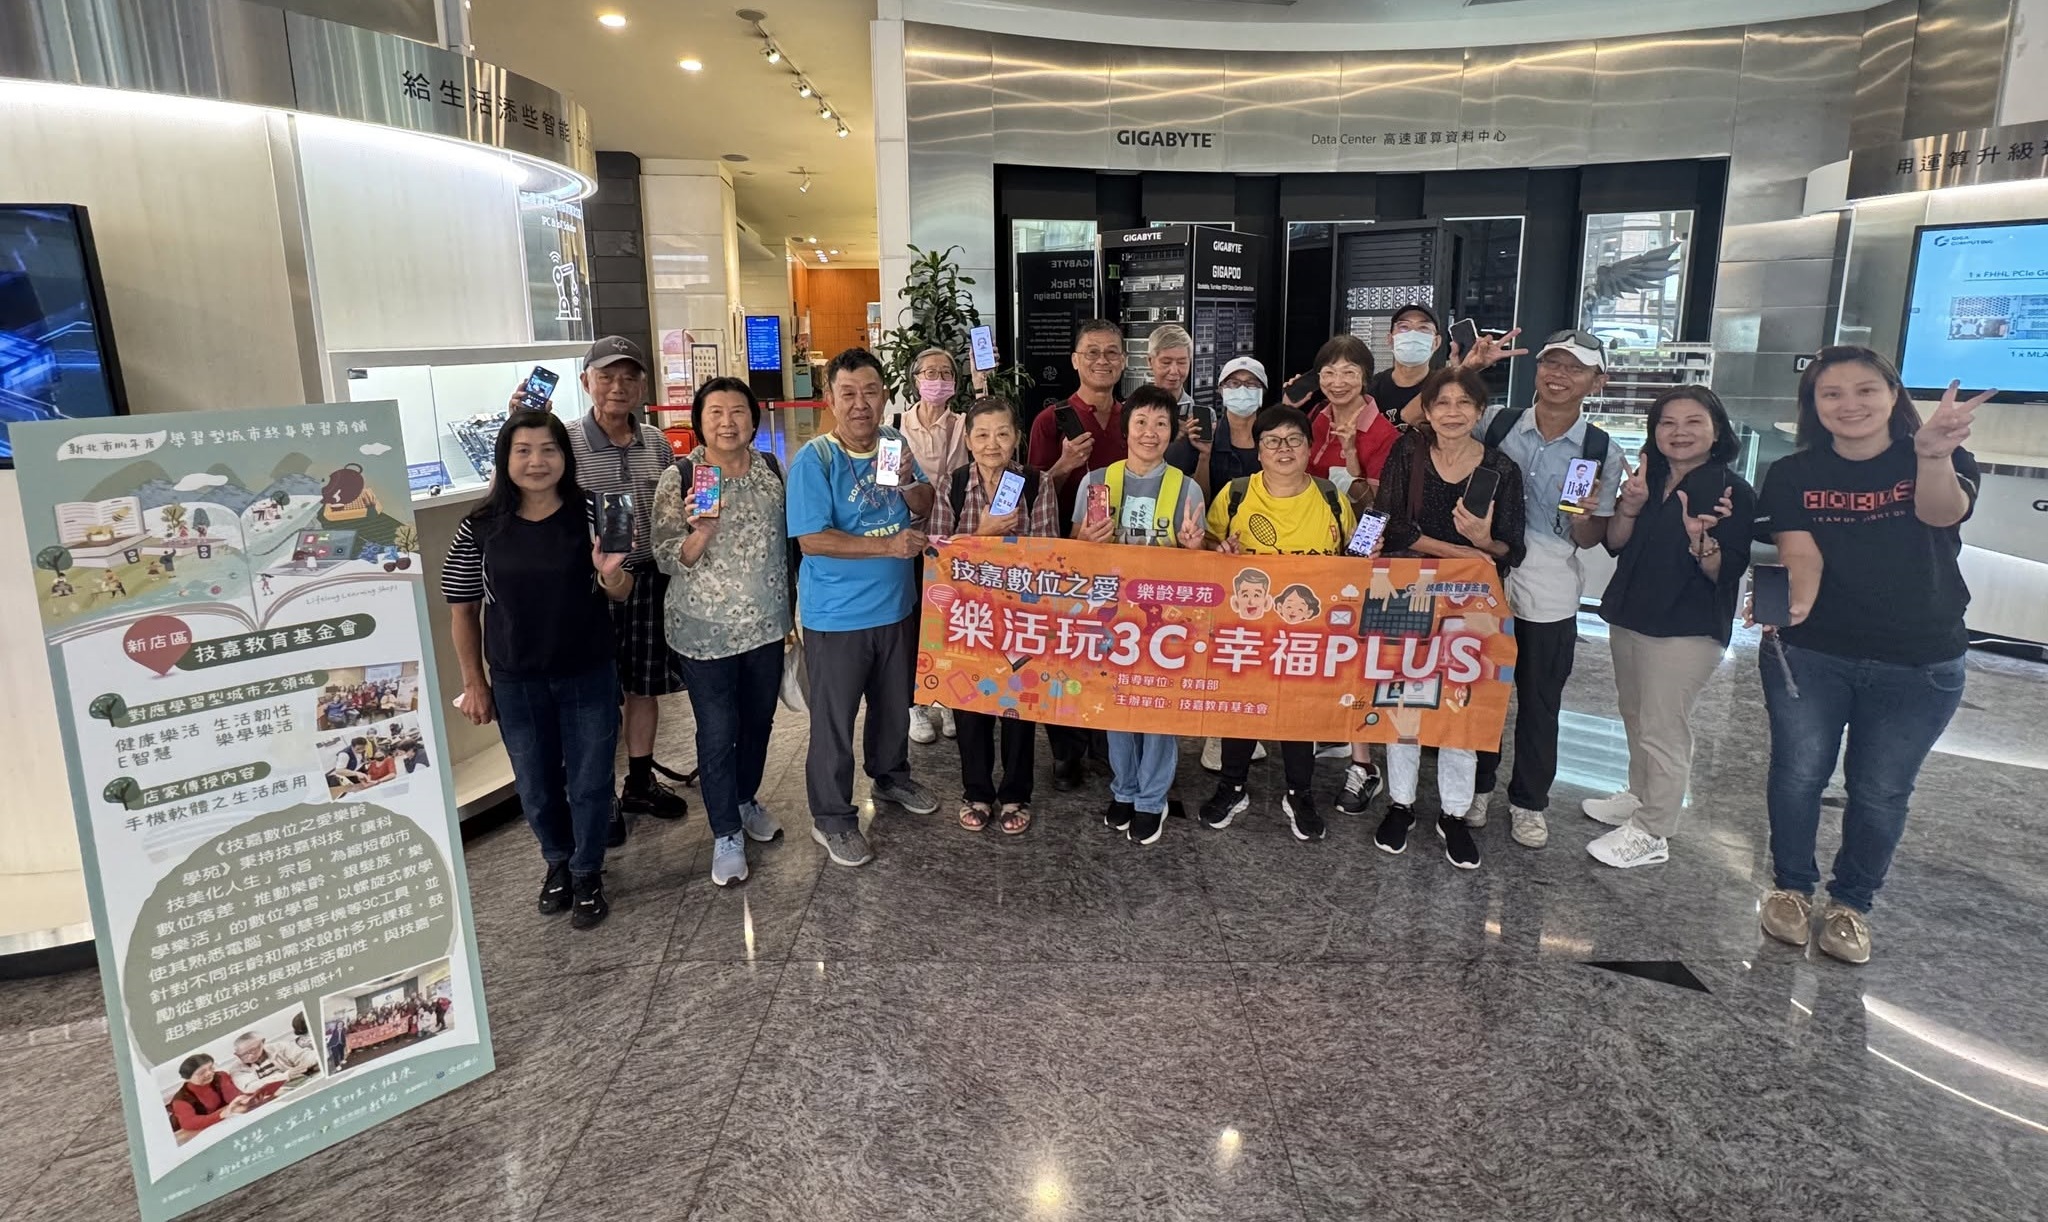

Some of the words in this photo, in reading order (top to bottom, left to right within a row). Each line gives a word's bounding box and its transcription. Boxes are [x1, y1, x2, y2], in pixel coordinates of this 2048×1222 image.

[402, 69, 571, 143] 給生活添些智能
[1116, 129, 1214, 148] GIGABYTE
[1311, 133, 1337, 145] Data
[1340, 133, 1377, 145] Center
[1383, 130, 1507, 146] 高速運算資料中心
[1123, 232, 1162, 242] GIGABYTE
[1213, 240, 1242, 253] GIGABYTE
[951, 557, 1120, 601] 技嘉數位之愛
[1137, 582, 1214, 603] 樂齡學苑
[126, 630, 189, 654] 新店區
[194, 618, 359, 663] 技嘉教育基金會
[127, 674, 316, 724] 對應學習型城市之領域
[115, 723, 201, 753] 健康樂活
[213, 703, 292, 732] 生活韌性
[118, 745, 173, 769] E智慧
[215, 719, 294, 747] 樂學樂活
[125, 774, 307, 832] 手機軟體之生活應用
[143, 766, 257, 805] 店家傳授內容
